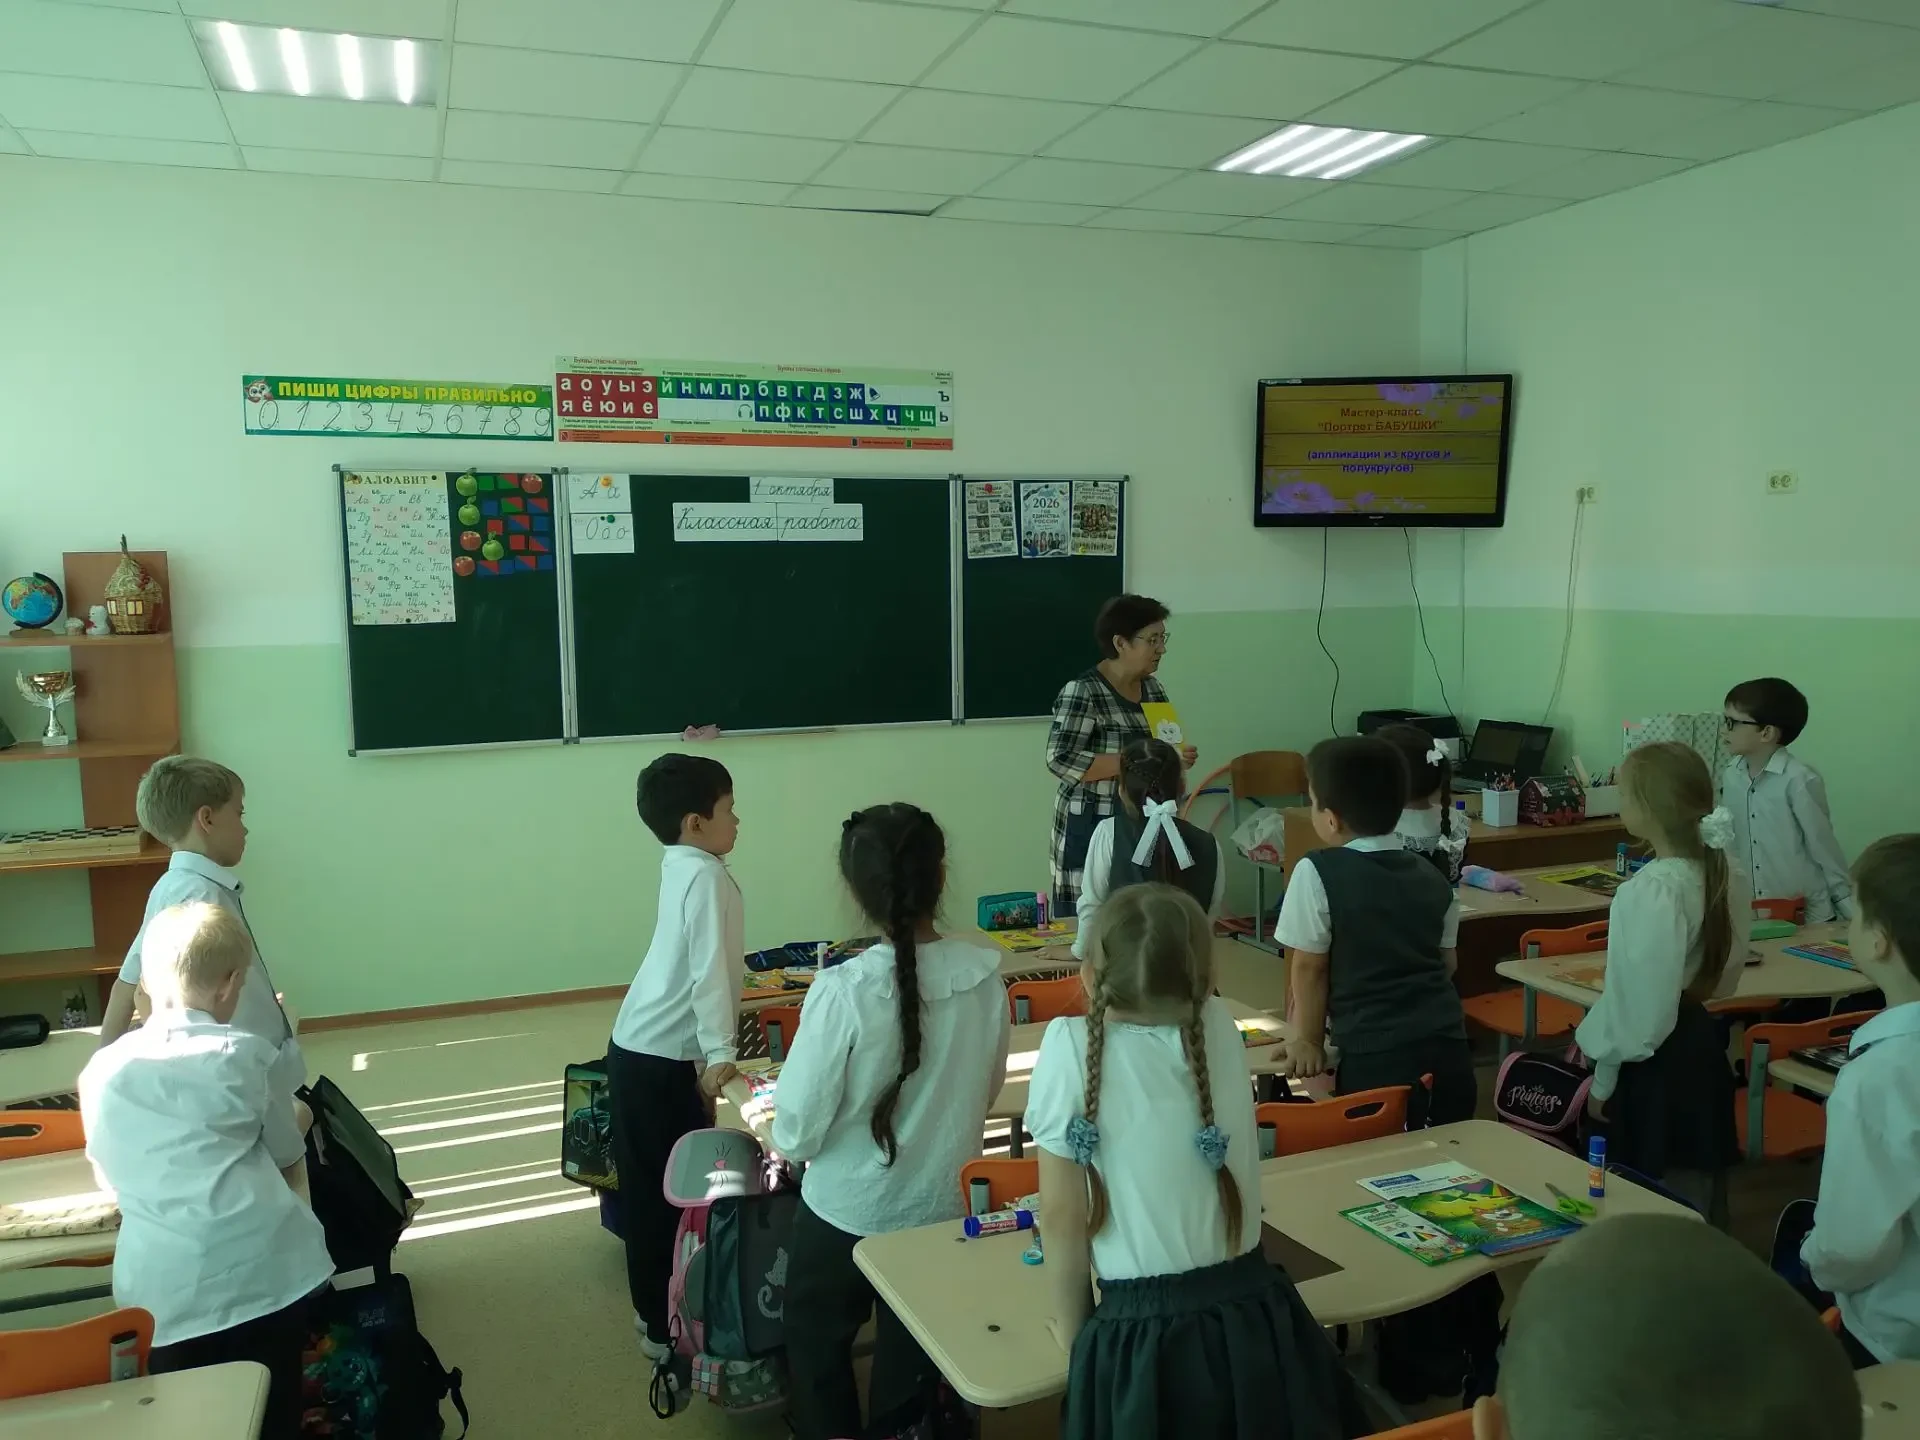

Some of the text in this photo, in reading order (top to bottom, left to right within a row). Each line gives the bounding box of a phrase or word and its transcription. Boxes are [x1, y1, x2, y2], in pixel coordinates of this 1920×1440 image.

[278, 382, 340, 398] ПИШИ
[345, 384, 418, 400] ЦИФРЫ
[424, 386, 537, 403] ПРАВИЛЬНО
[259, 400, 551, 436] 0 1 2 3 4 5 6 7 8 9
[1340, 408, 1421, 418] Мастер-класс
[364, 476, 429, 485] АЛФАВИТ
[768, 479, 833, 503] октября
[1033, 497, 1060, 509] 2026
[676, 507, 862, 538] Классная работа
